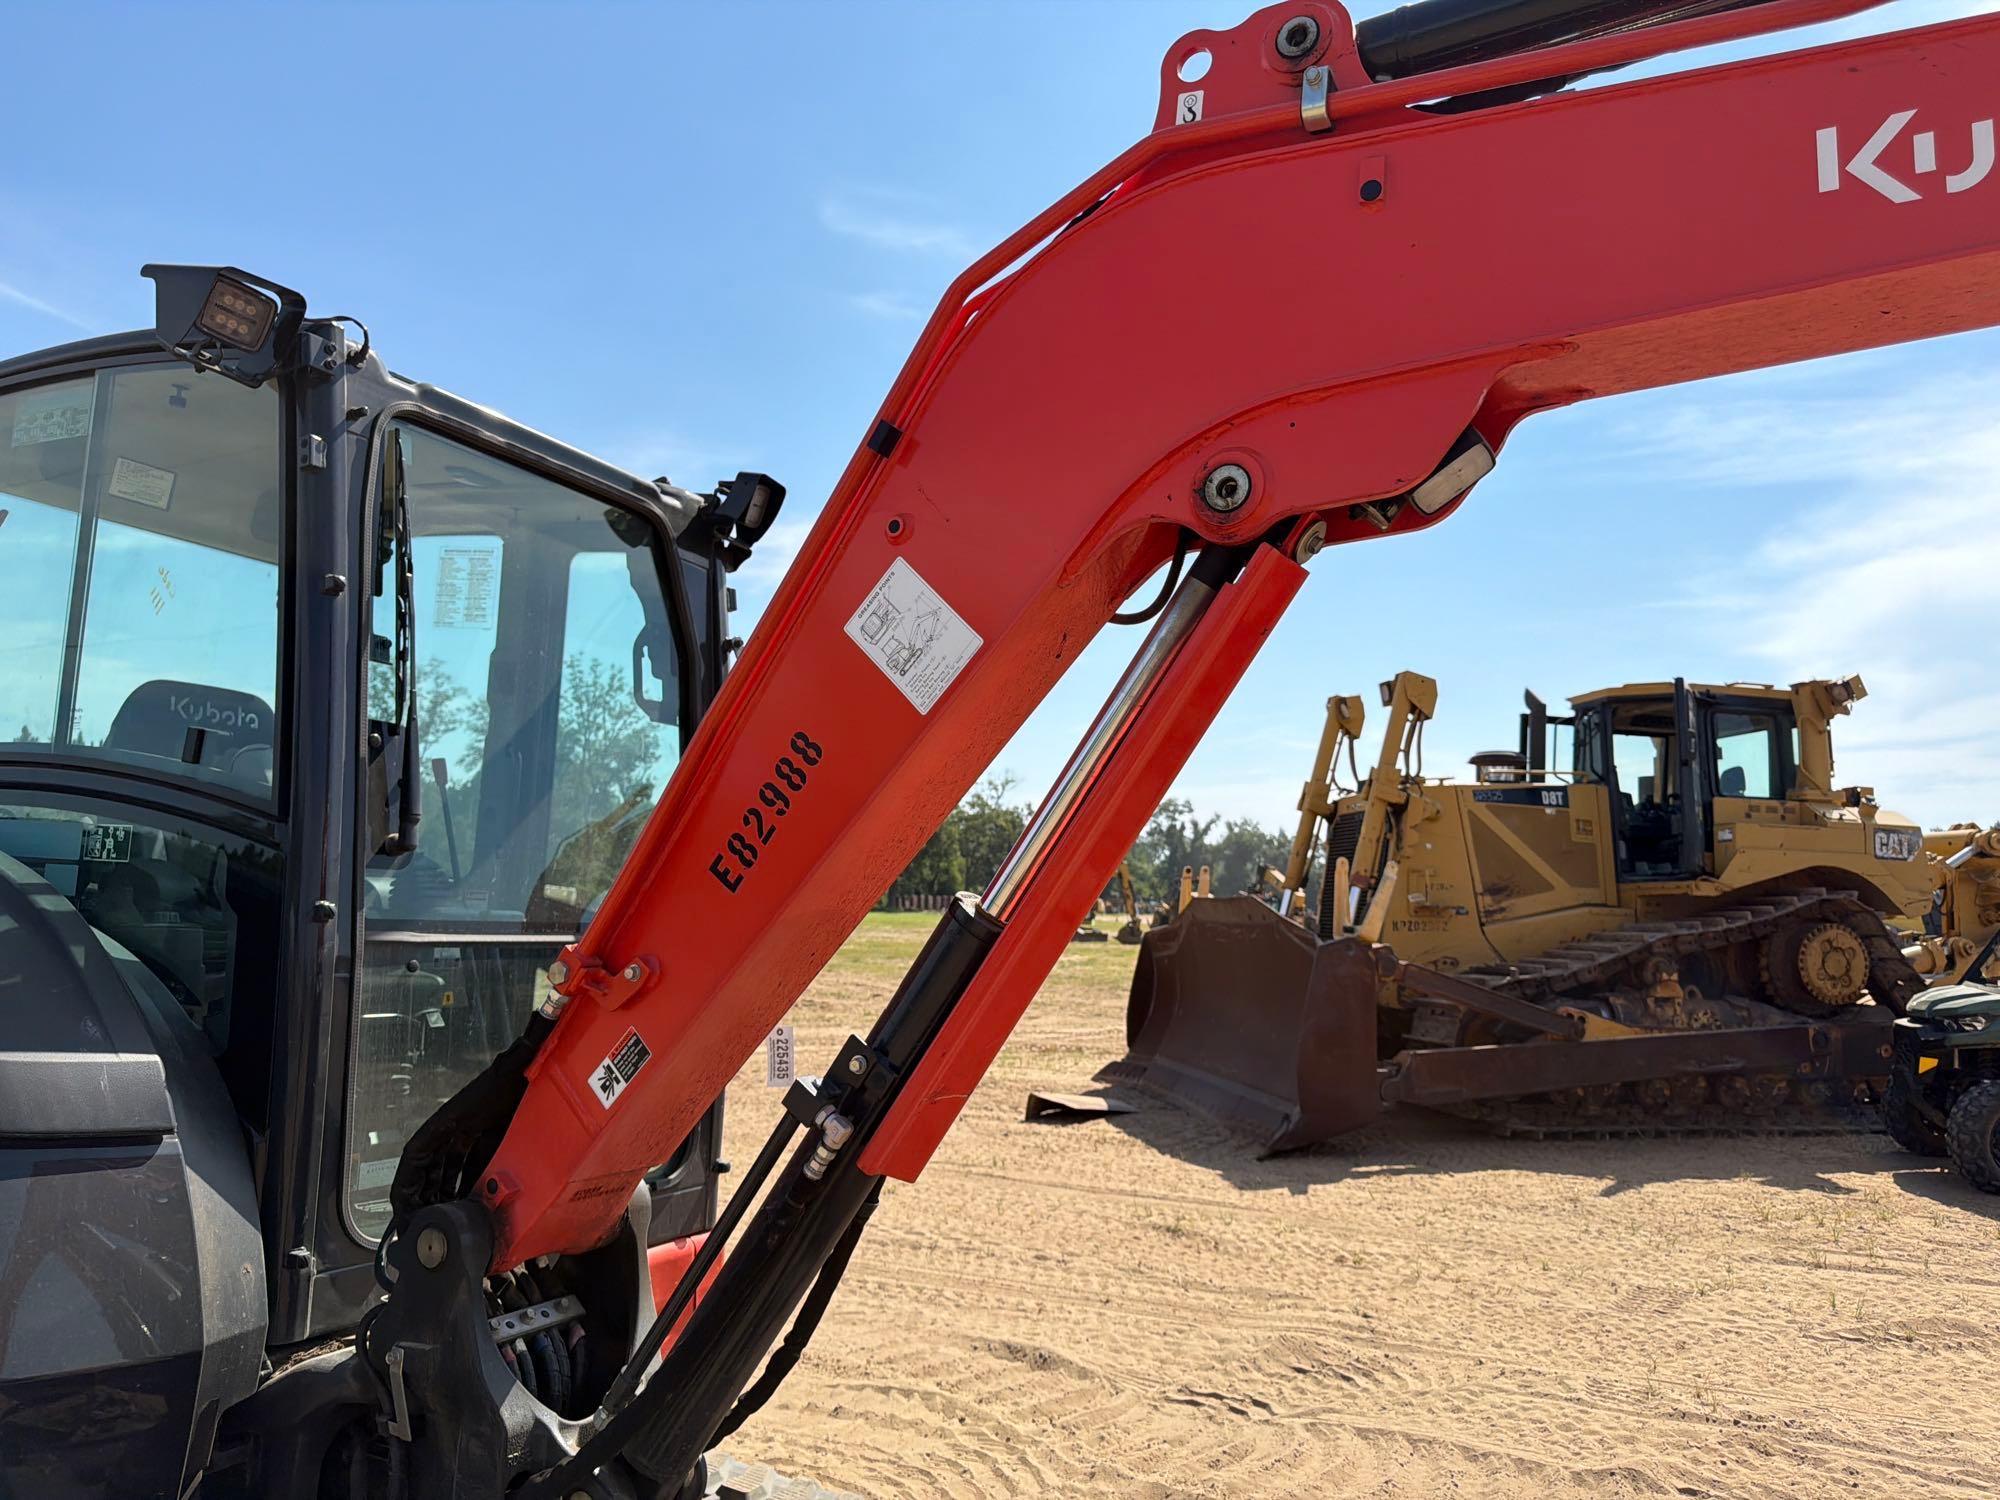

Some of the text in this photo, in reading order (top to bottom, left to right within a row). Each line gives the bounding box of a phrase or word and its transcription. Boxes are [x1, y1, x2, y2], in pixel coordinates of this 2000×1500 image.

[857, 571, 896, 619] GREASING POINTS
[169, 695, 260, 730] Kubota
[708, 731, 824, 894] E82988
[1541, 790, 1564, 806] D8T
[1875, 831, 1911, 859] CAT
[776, 1038, 789, 1080] 225435
